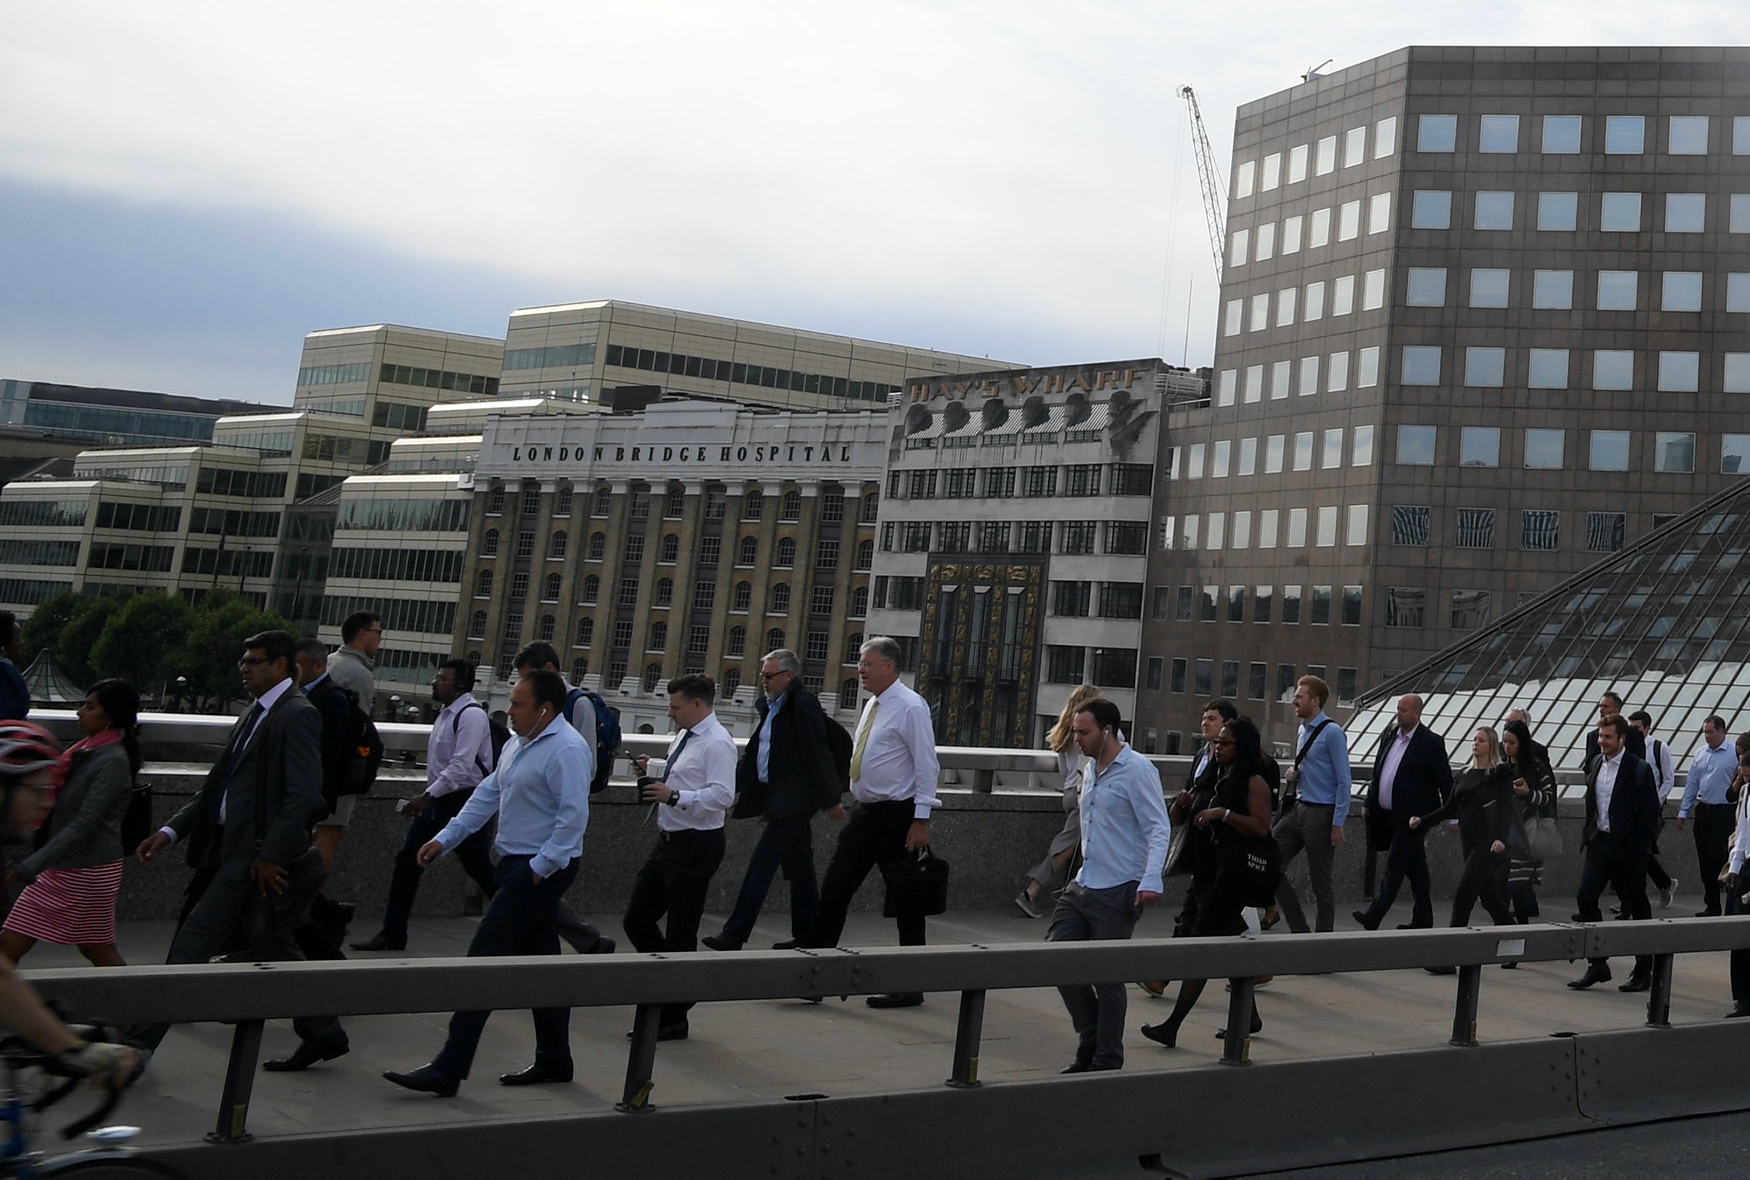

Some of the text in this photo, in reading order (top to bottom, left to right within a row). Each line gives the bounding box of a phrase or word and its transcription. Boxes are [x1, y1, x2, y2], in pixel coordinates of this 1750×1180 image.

[911, 370, 1142, 403] HAY'S WHARF
[512, 446, 850, 462] LONDON BRIDGE HOSPITAL
